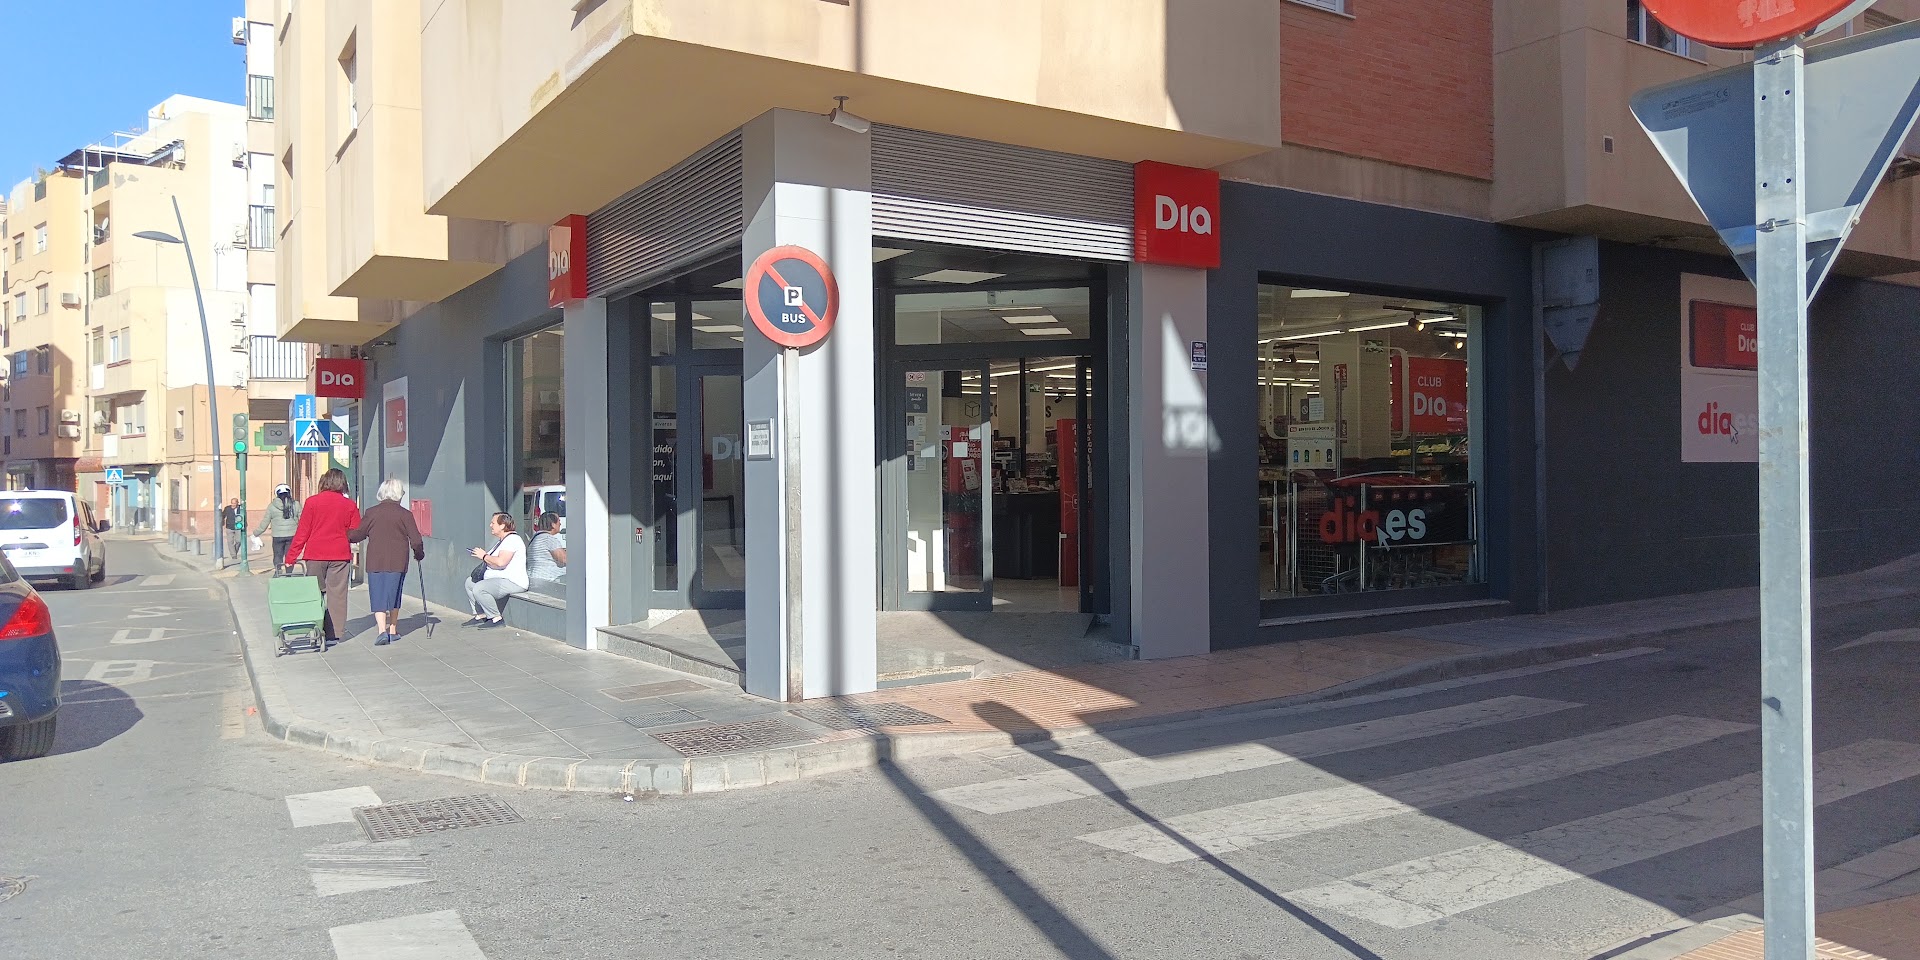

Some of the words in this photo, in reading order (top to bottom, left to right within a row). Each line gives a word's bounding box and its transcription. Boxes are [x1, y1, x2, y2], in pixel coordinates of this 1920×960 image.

[1155, 194, 1212, 235] Dia
[788, 289, 799, 303] P
[781, 312, 806, 324] BUS
[1740, 322, 1755, 332] CLUB
[321, 370, 354, 386] Dia
[1417, 375, 1442, 388] CLUB
[1413, 391, 1447, 417] Dia
[653, 444, 673, 454] dido
[712, 436, 745, 460] Di
